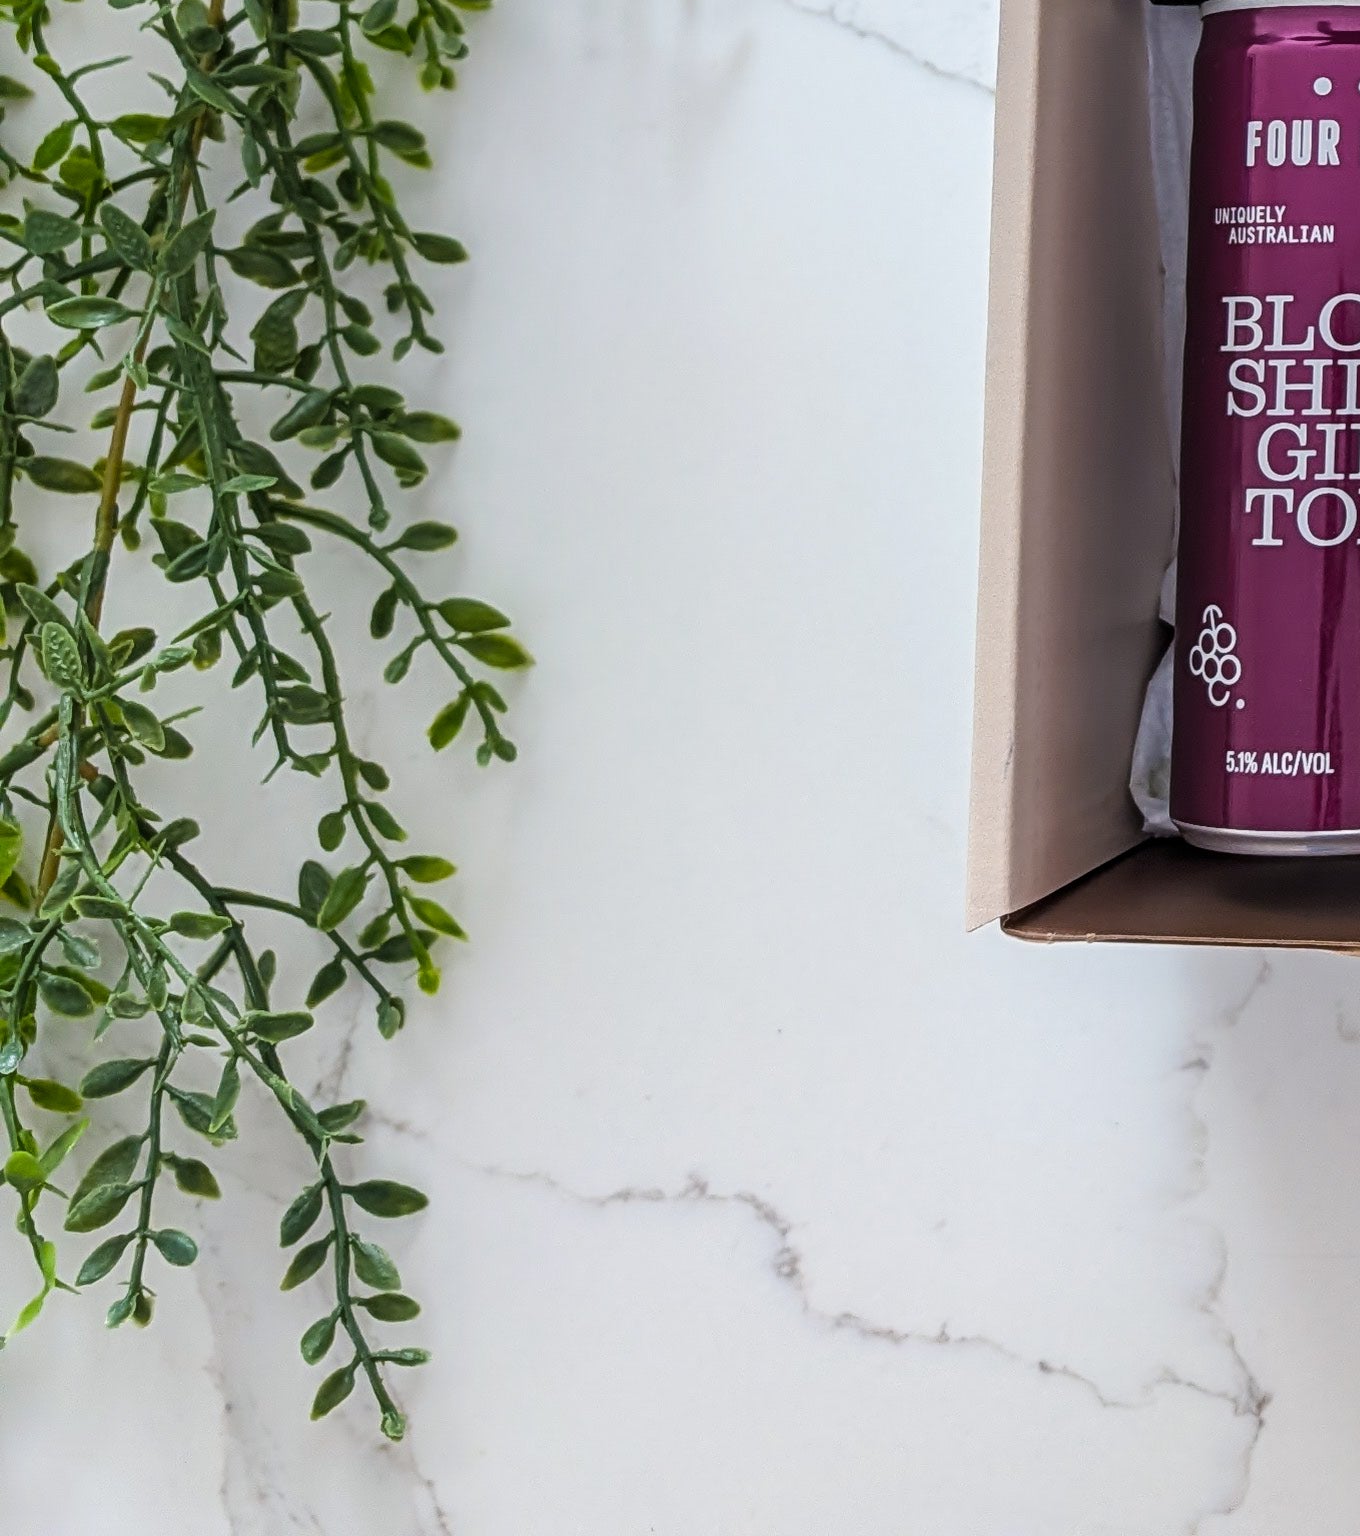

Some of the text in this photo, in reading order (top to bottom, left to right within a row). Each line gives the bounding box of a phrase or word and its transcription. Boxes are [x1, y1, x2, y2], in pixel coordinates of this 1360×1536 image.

[1246, 119, 1340, 167] FOUR
[1215, 205, 1286, 225] UNIQUELY
[1228, 225, 1334, 244] AUSTRALIAN
[1226, 750, 1334, 776] 5.1% ALC/VOL
